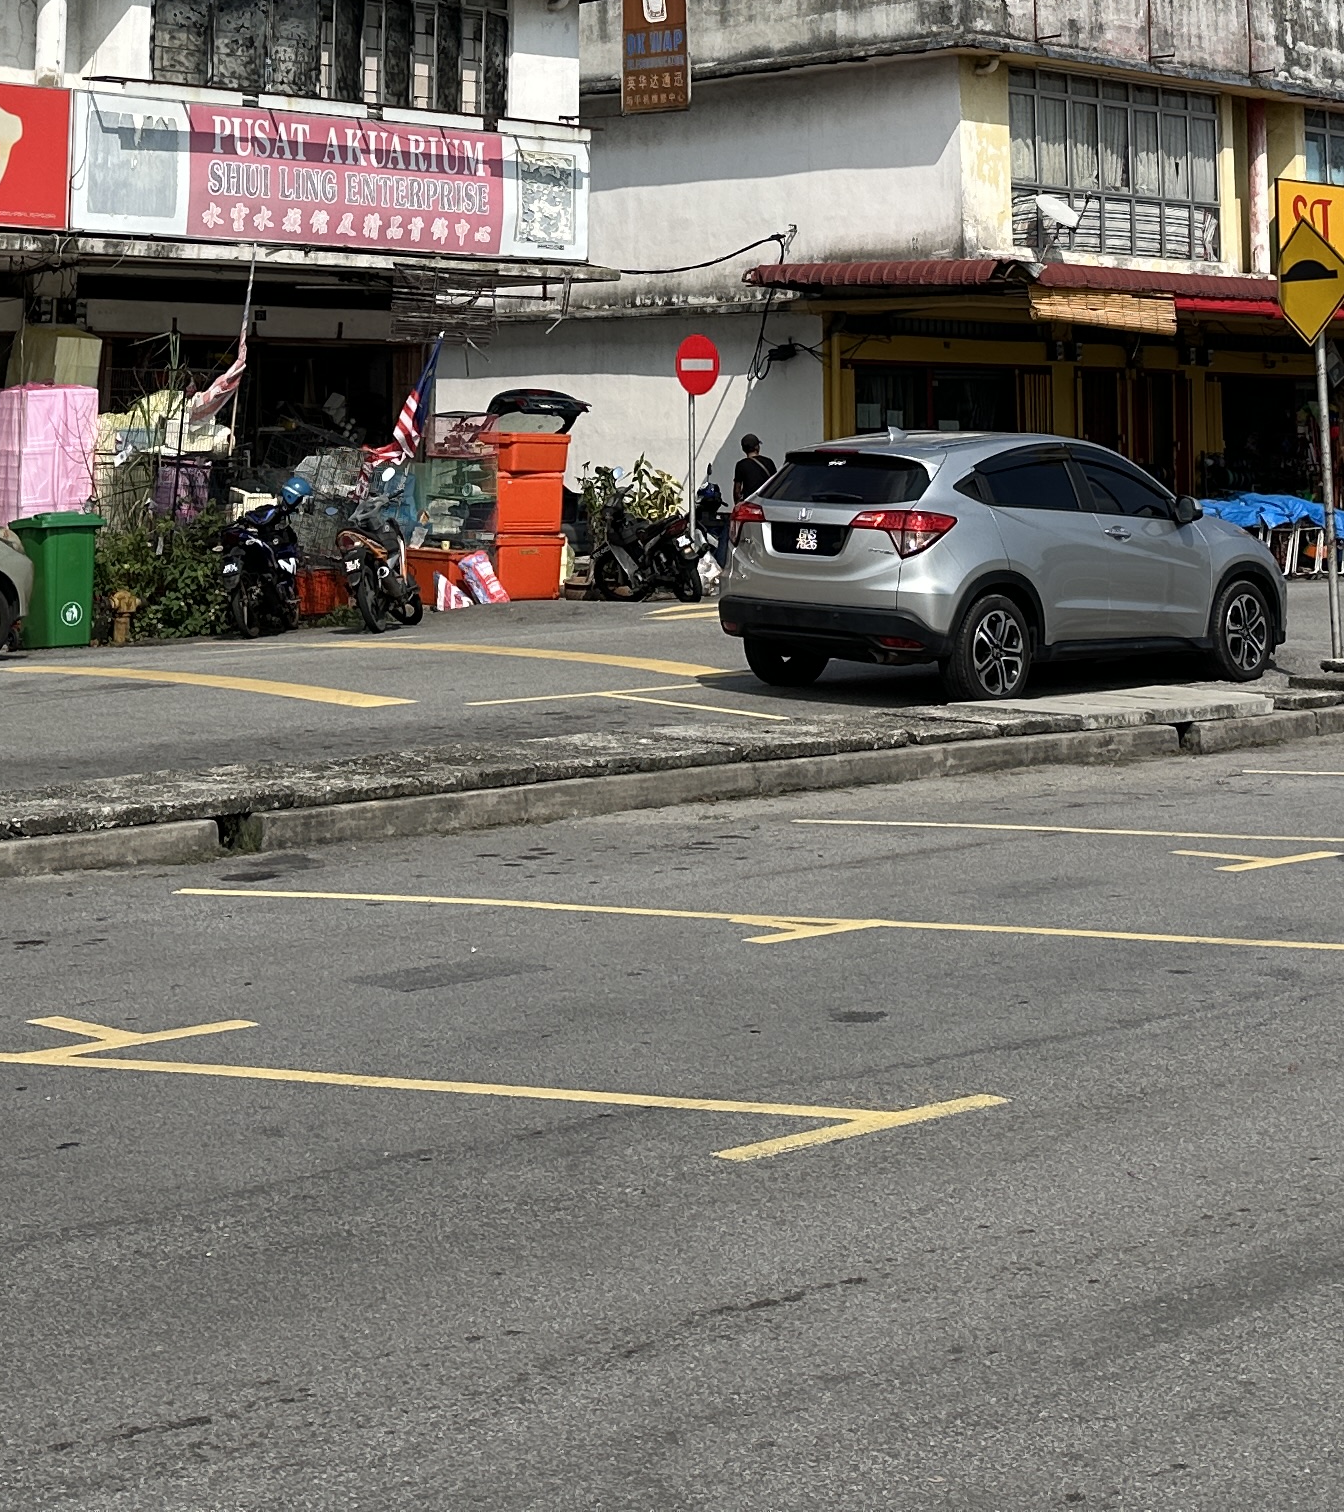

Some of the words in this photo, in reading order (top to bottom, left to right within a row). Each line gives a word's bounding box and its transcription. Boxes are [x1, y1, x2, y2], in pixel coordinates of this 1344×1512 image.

[650, 29, 683, 54] WAP
[212, 115, 310, 161] PUSAT
[323, 126, 486, 177] AKUARIUM
[208, 159, 271, 198] SHUI
[279, 165, 338, 205] LING
[345, 171, 490, 216] ENTERPRISE
